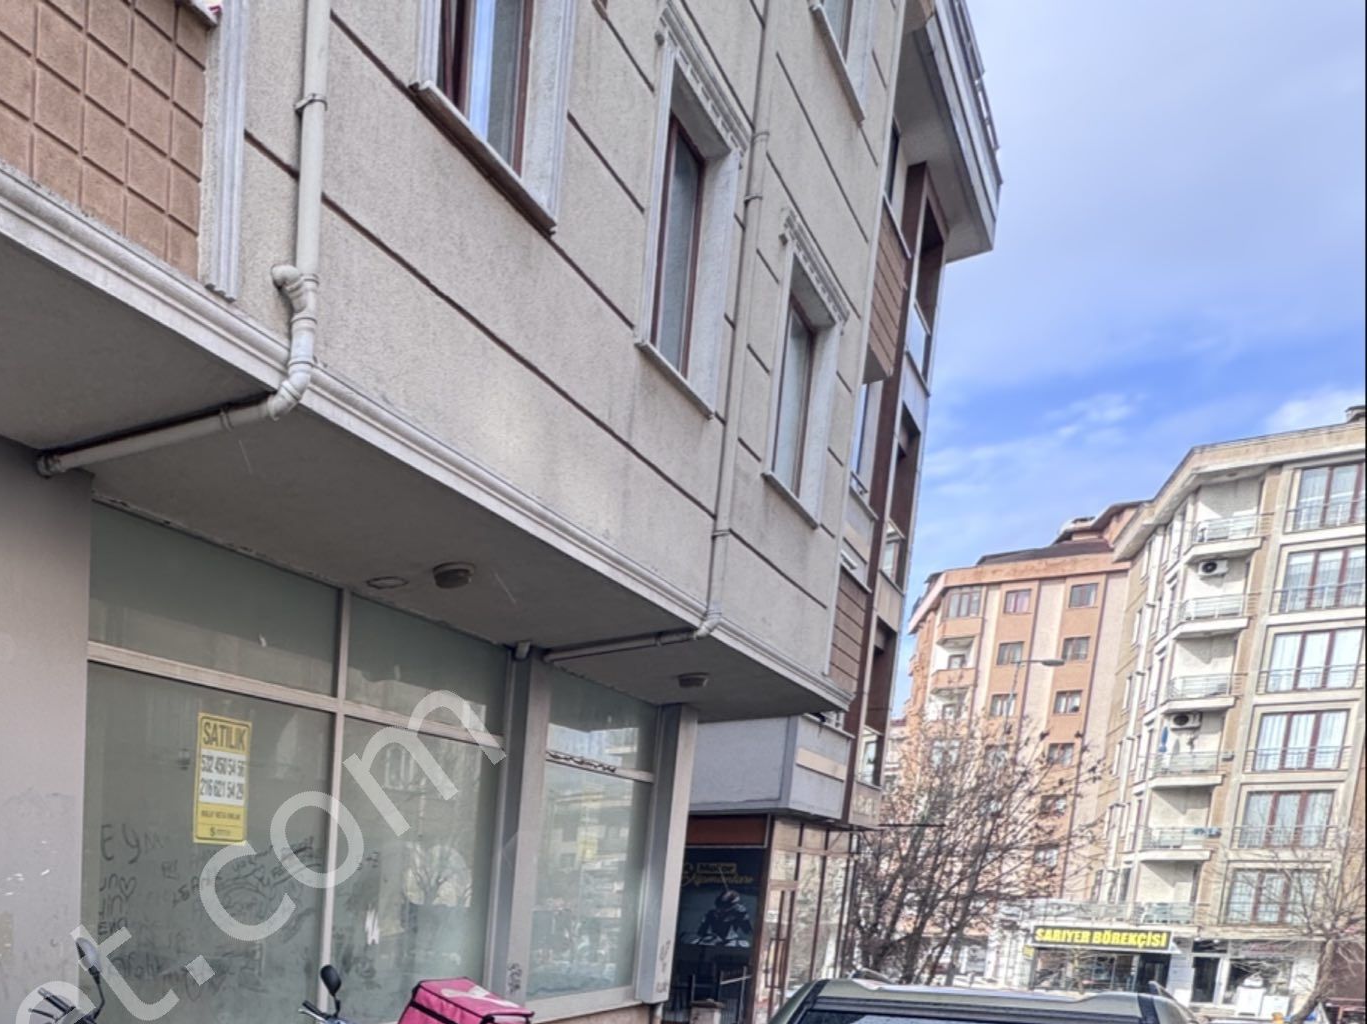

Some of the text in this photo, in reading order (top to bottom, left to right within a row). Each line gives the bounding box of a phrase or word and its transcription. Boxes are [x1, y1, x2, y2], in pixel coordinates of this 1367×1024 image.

[203, 722, 246, 751] SATILIK
[1035, 927, 1167, 948] SARIYER BÖREKÇİSİ
